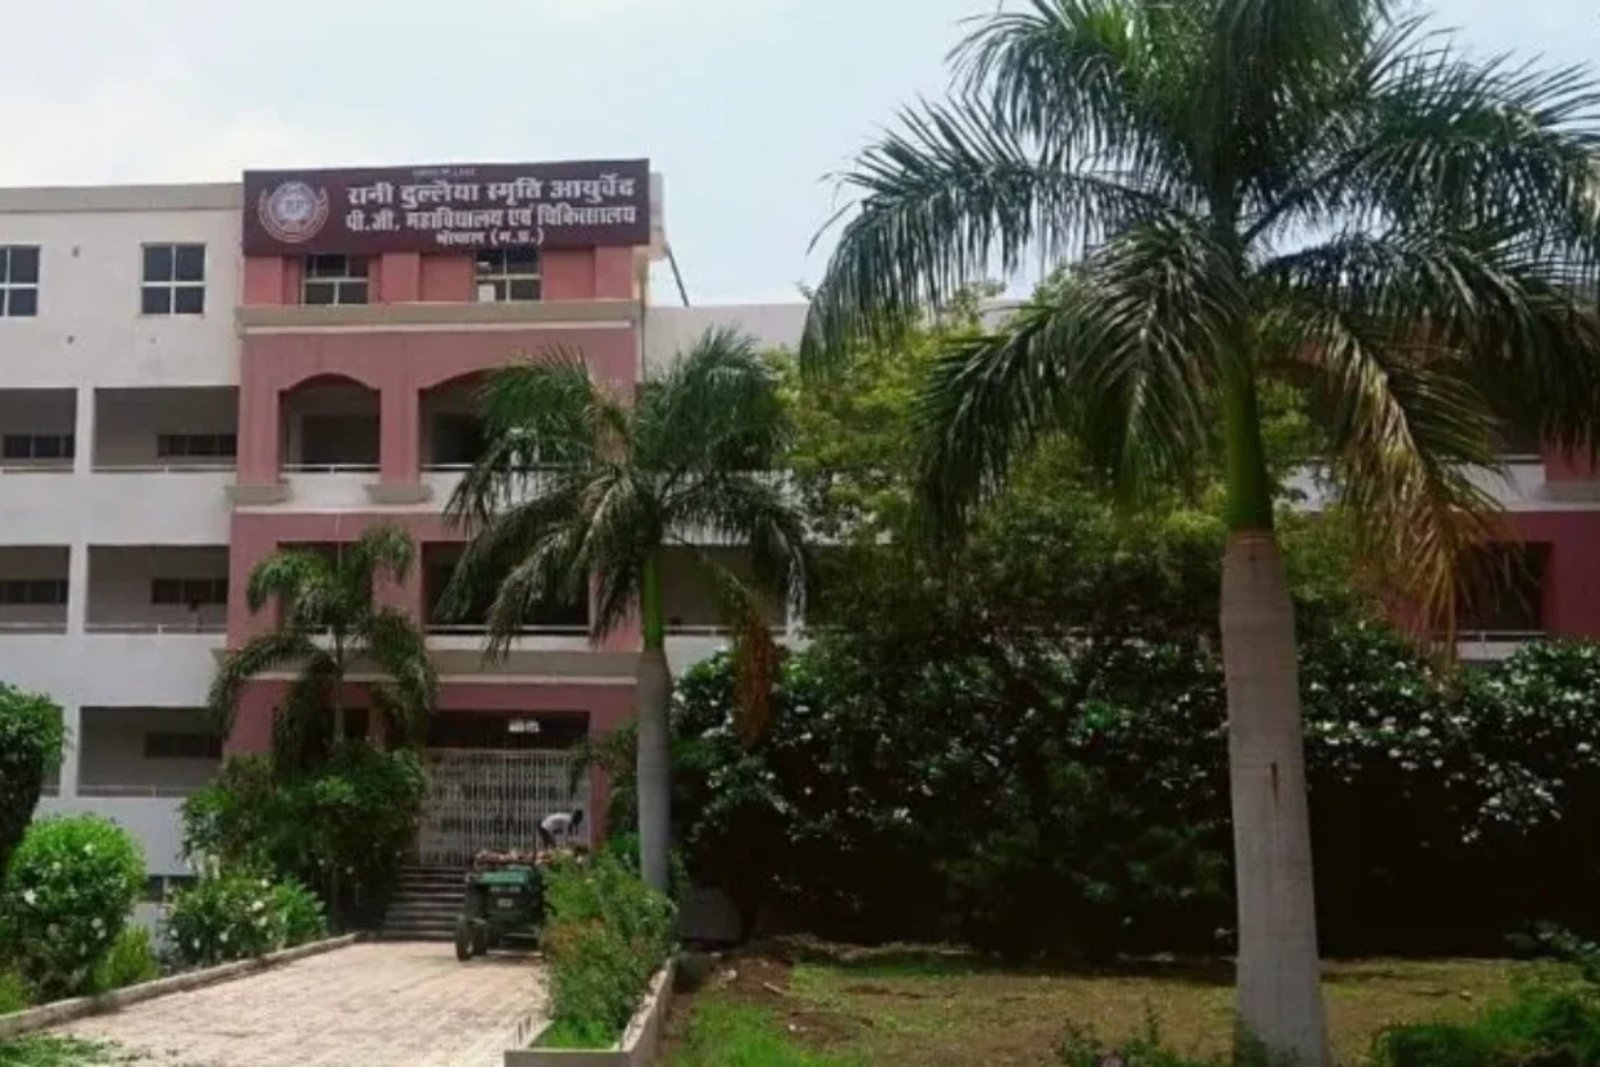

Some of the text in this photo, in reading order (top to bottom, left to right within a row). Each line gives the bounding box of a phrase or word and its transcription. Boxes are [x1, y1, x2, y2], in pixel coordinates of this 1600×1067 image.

[346, 182, 394, 205] रानी
[486, 177, 542, 205] स्मृति
[550, 173, 636, 203] आयुर्वेद
[508, 203, 533, 226] एवं
